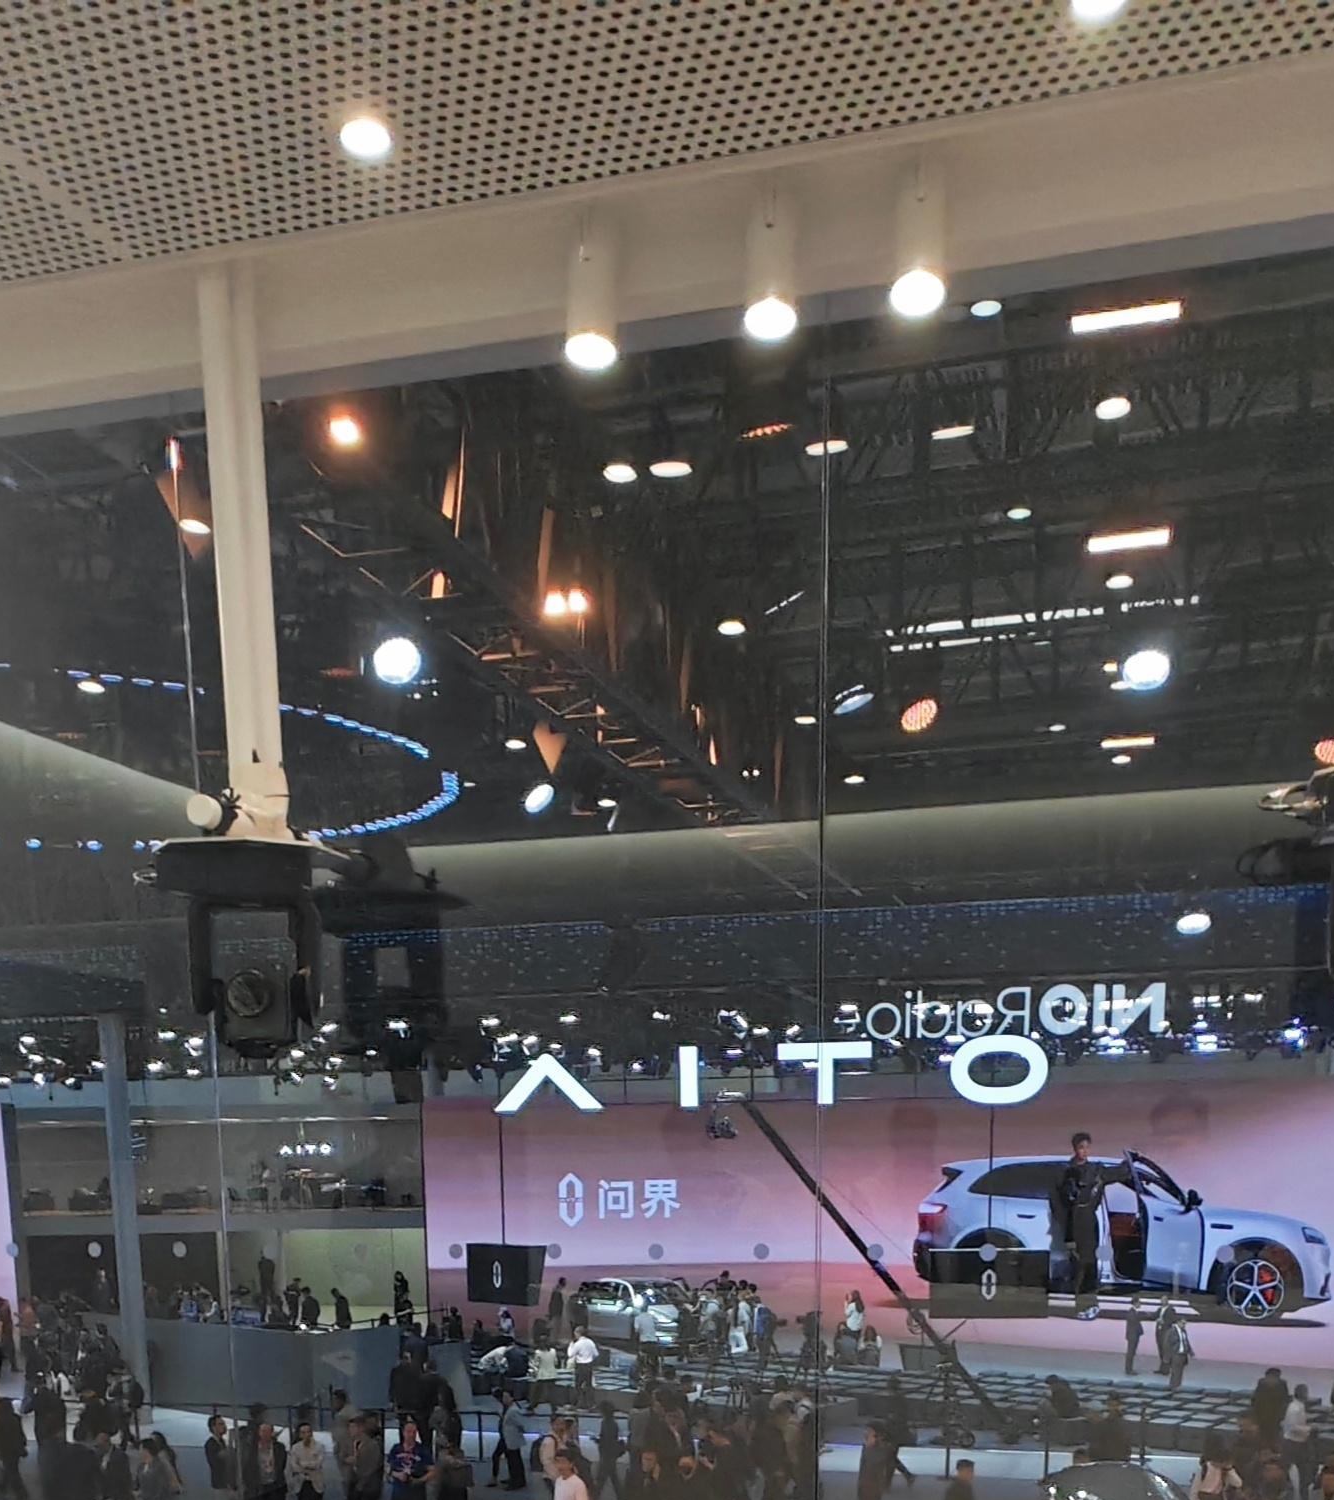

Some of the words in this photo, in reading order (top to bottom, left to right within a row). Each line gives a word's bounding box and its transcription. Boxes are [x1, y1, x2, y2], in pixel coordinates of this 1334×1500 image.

[494, 1034, 1049, 1112] AITO
[278, 1142, 333, 1156] AITO
[598, 1179, 681, 1220] 问界
